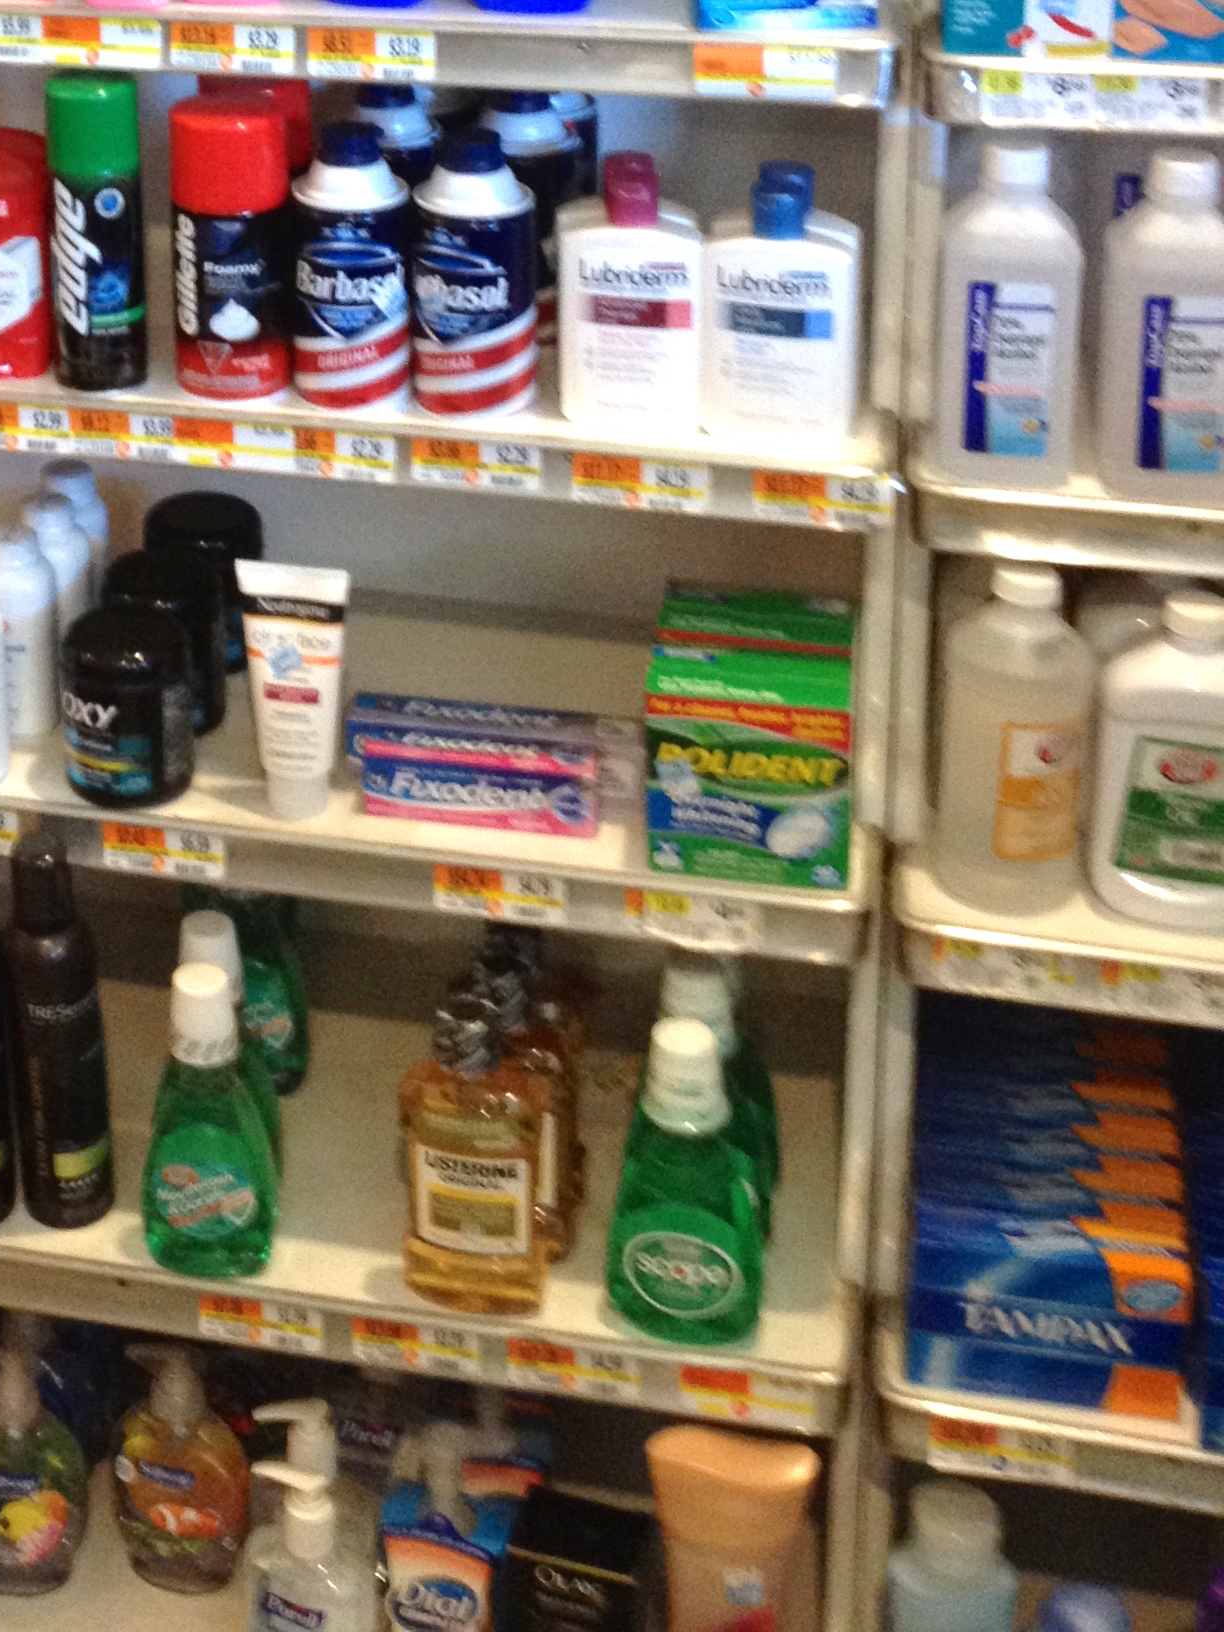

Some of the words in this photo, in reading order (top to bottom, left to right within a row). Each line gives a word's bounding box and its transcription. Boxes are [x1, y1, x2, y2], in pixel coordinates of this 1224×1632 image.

[578, 260, 690, 291] Lubriderm
[715, 265, 832, 300] Lubriderm
[317, 345, 378, 369] ORIGINAL
[62, 689, 118, 729] OXY
[958, 1296, 1134, 1358] TAMPAX
[400, 1581, 476, 1621] Dial
